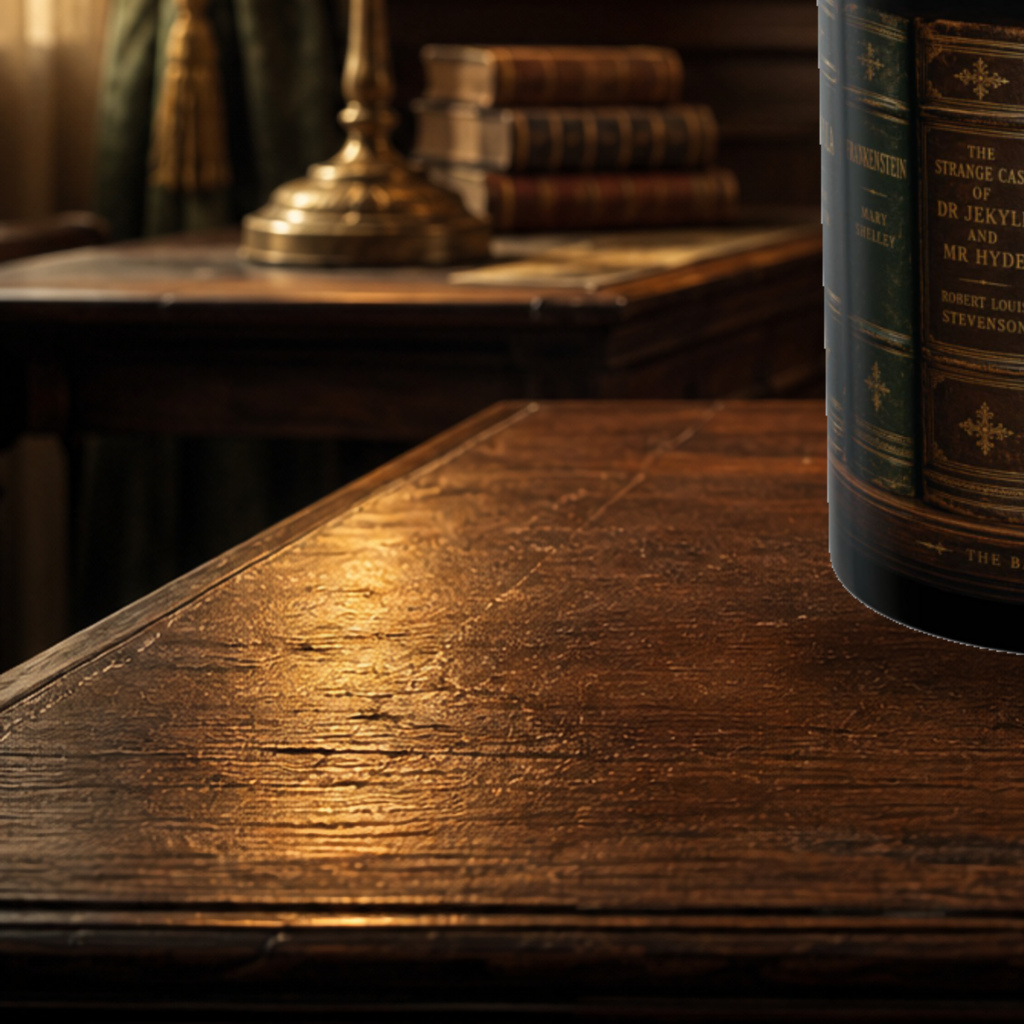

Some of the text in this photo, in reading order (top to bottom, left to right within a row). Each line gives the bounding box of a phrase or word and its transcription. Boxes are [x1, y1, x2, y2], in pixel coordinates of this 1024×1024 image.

[967, 145, 995, 161] THE
[935, 159, 994, 182] STRANGE
[972, 186, 991, 201] OF
[861, 206, 887, 227] MARY
[937, 200, 958, 219] DR
[855, 223, 896, 249] SHELLEY
[967, 229, 998, 244] AND
[943, 243, 968, 262] MR
[941, 290, 987, 309] ROBERT
[966, 548, 1001, 567] THE
